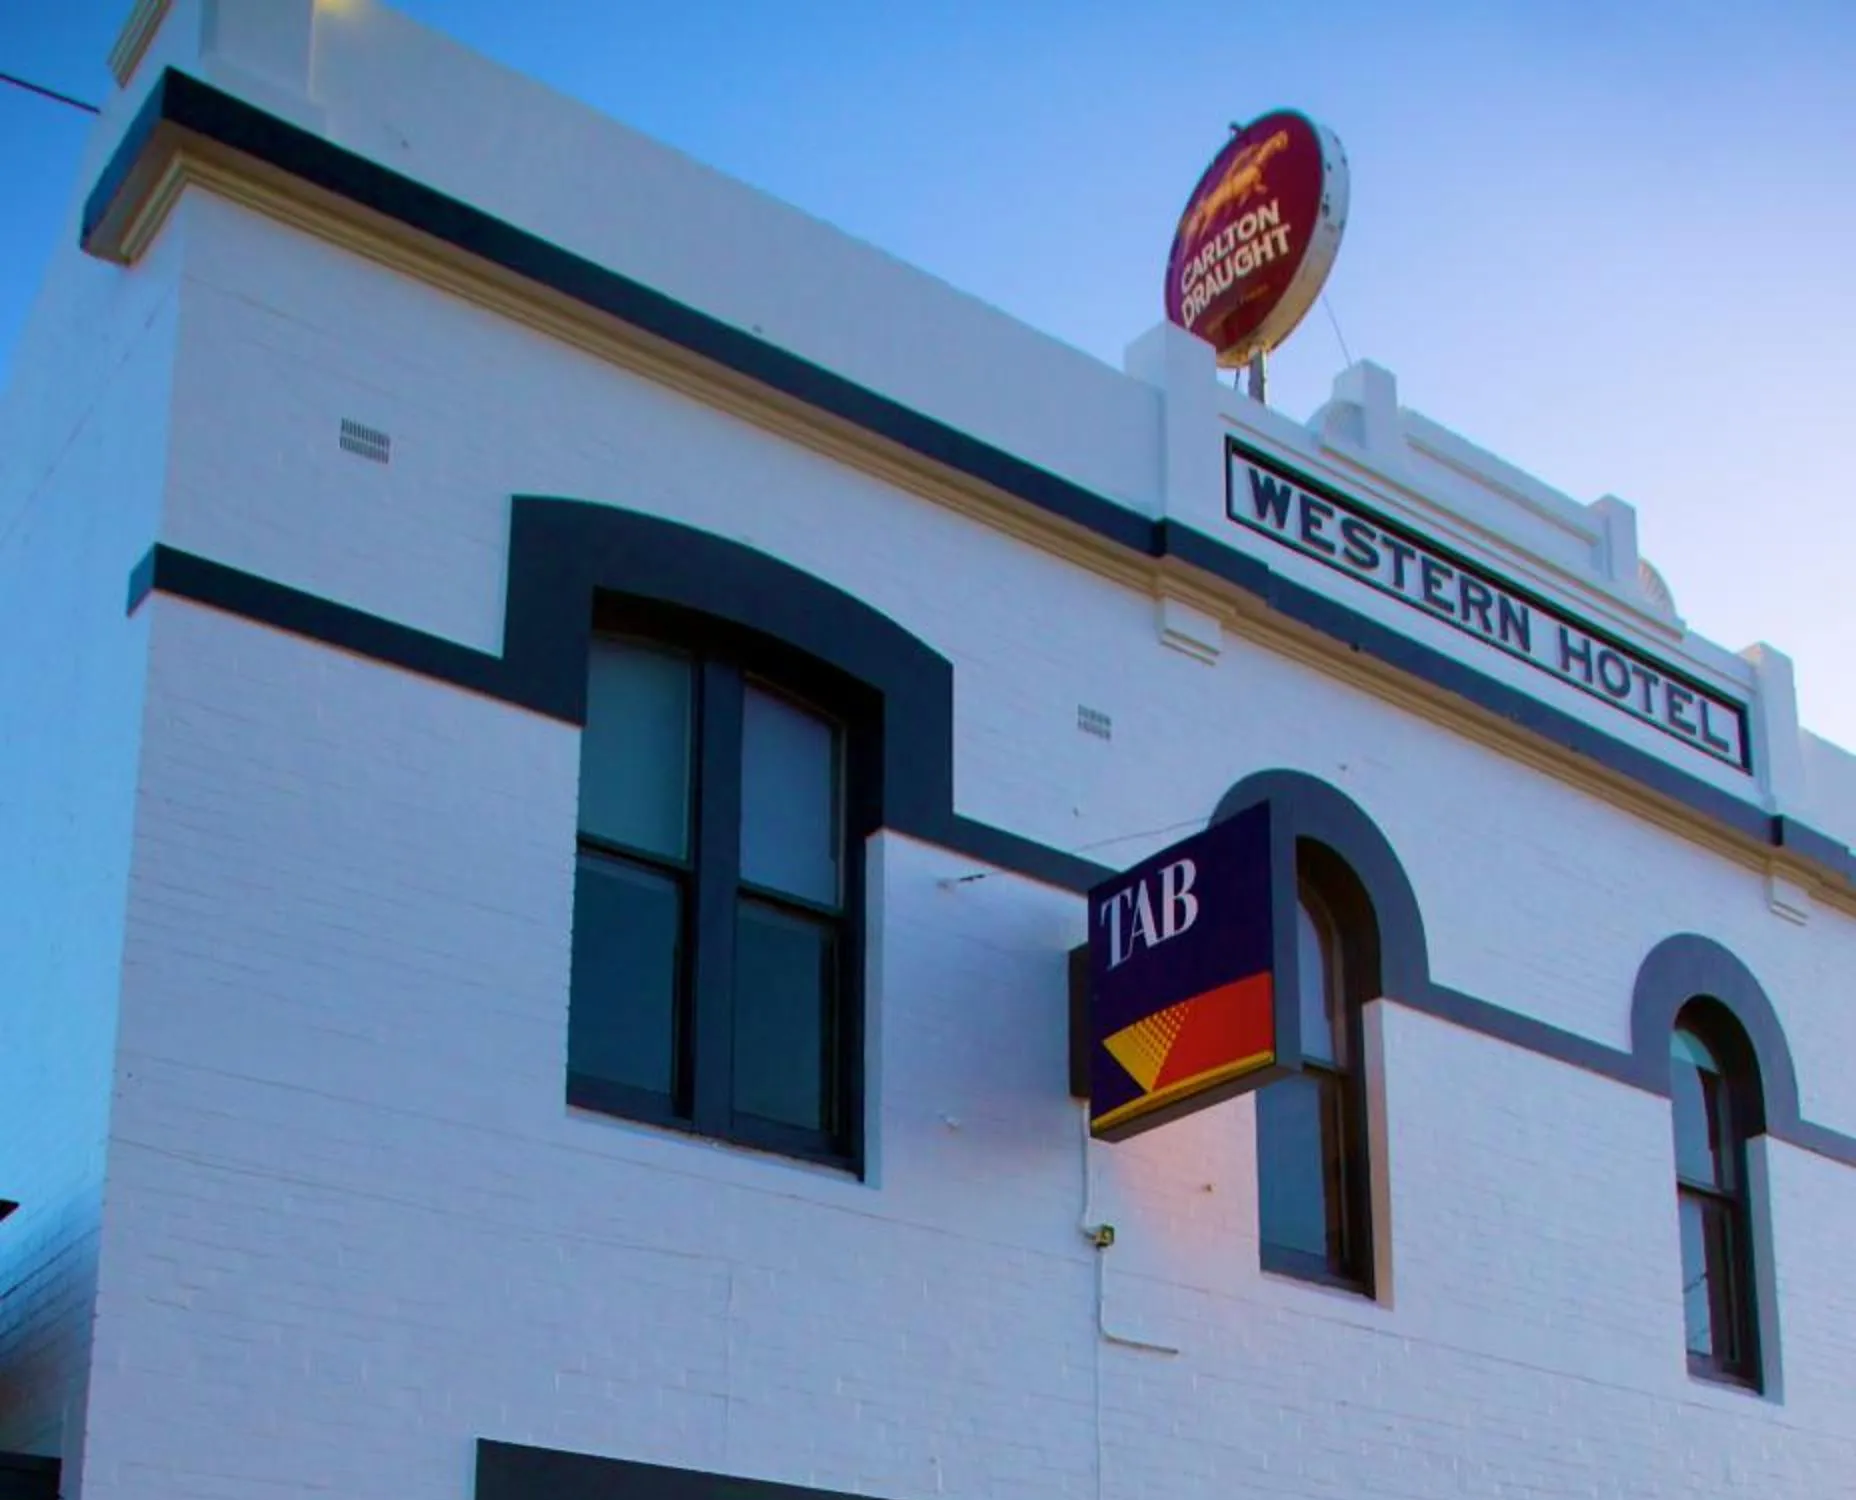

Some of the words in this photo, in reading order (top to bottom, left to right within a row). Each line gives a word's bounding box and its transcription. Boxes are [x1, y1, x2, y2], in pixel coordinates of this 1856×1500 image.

[1181, 198, 1280, 292] CARLTON
[1181, 224, 1291, 328] DRAUGHT
[1249, 467, 1532, 653] WESTERN
[1557, 623, 1730, 752] HOTEL
[1101, 858, 1199, 970] TAB
